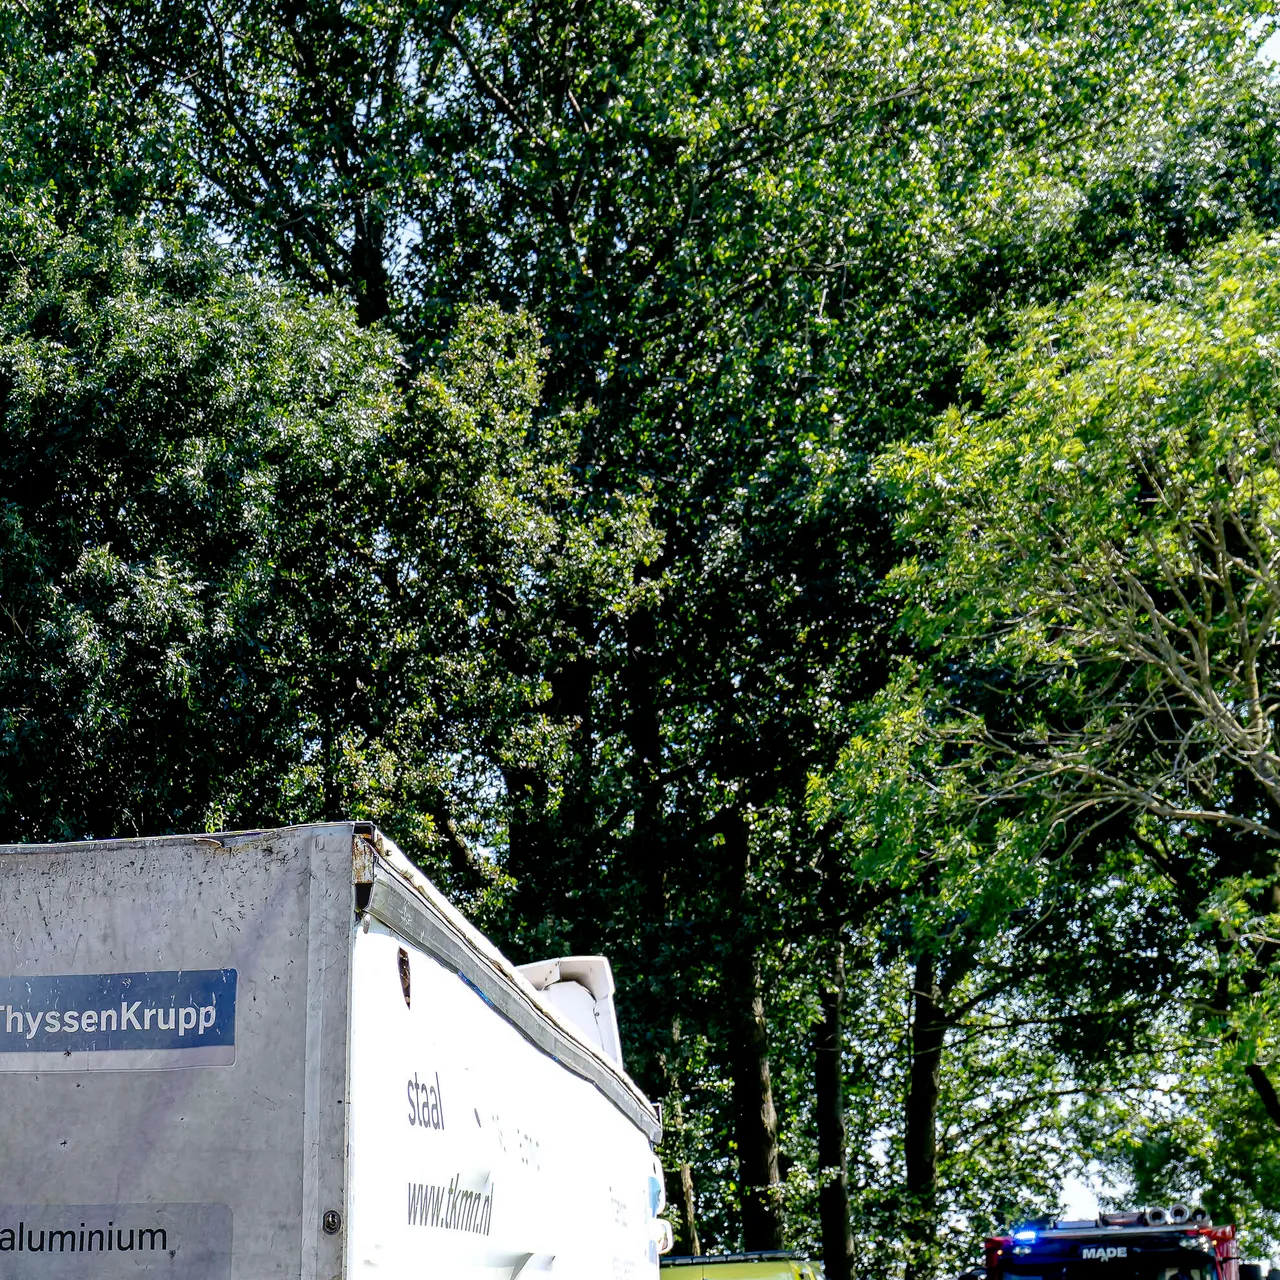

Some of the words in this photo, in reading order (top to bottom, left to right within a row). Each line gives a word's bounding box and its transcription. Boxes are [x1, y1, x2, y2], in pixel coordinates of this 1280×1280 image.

[406, 1071, 445, 1131] staal
[407, 1172, 495, 1236] www.tkmn.nl
[1082, 1246, 1128, 1260] MADE
